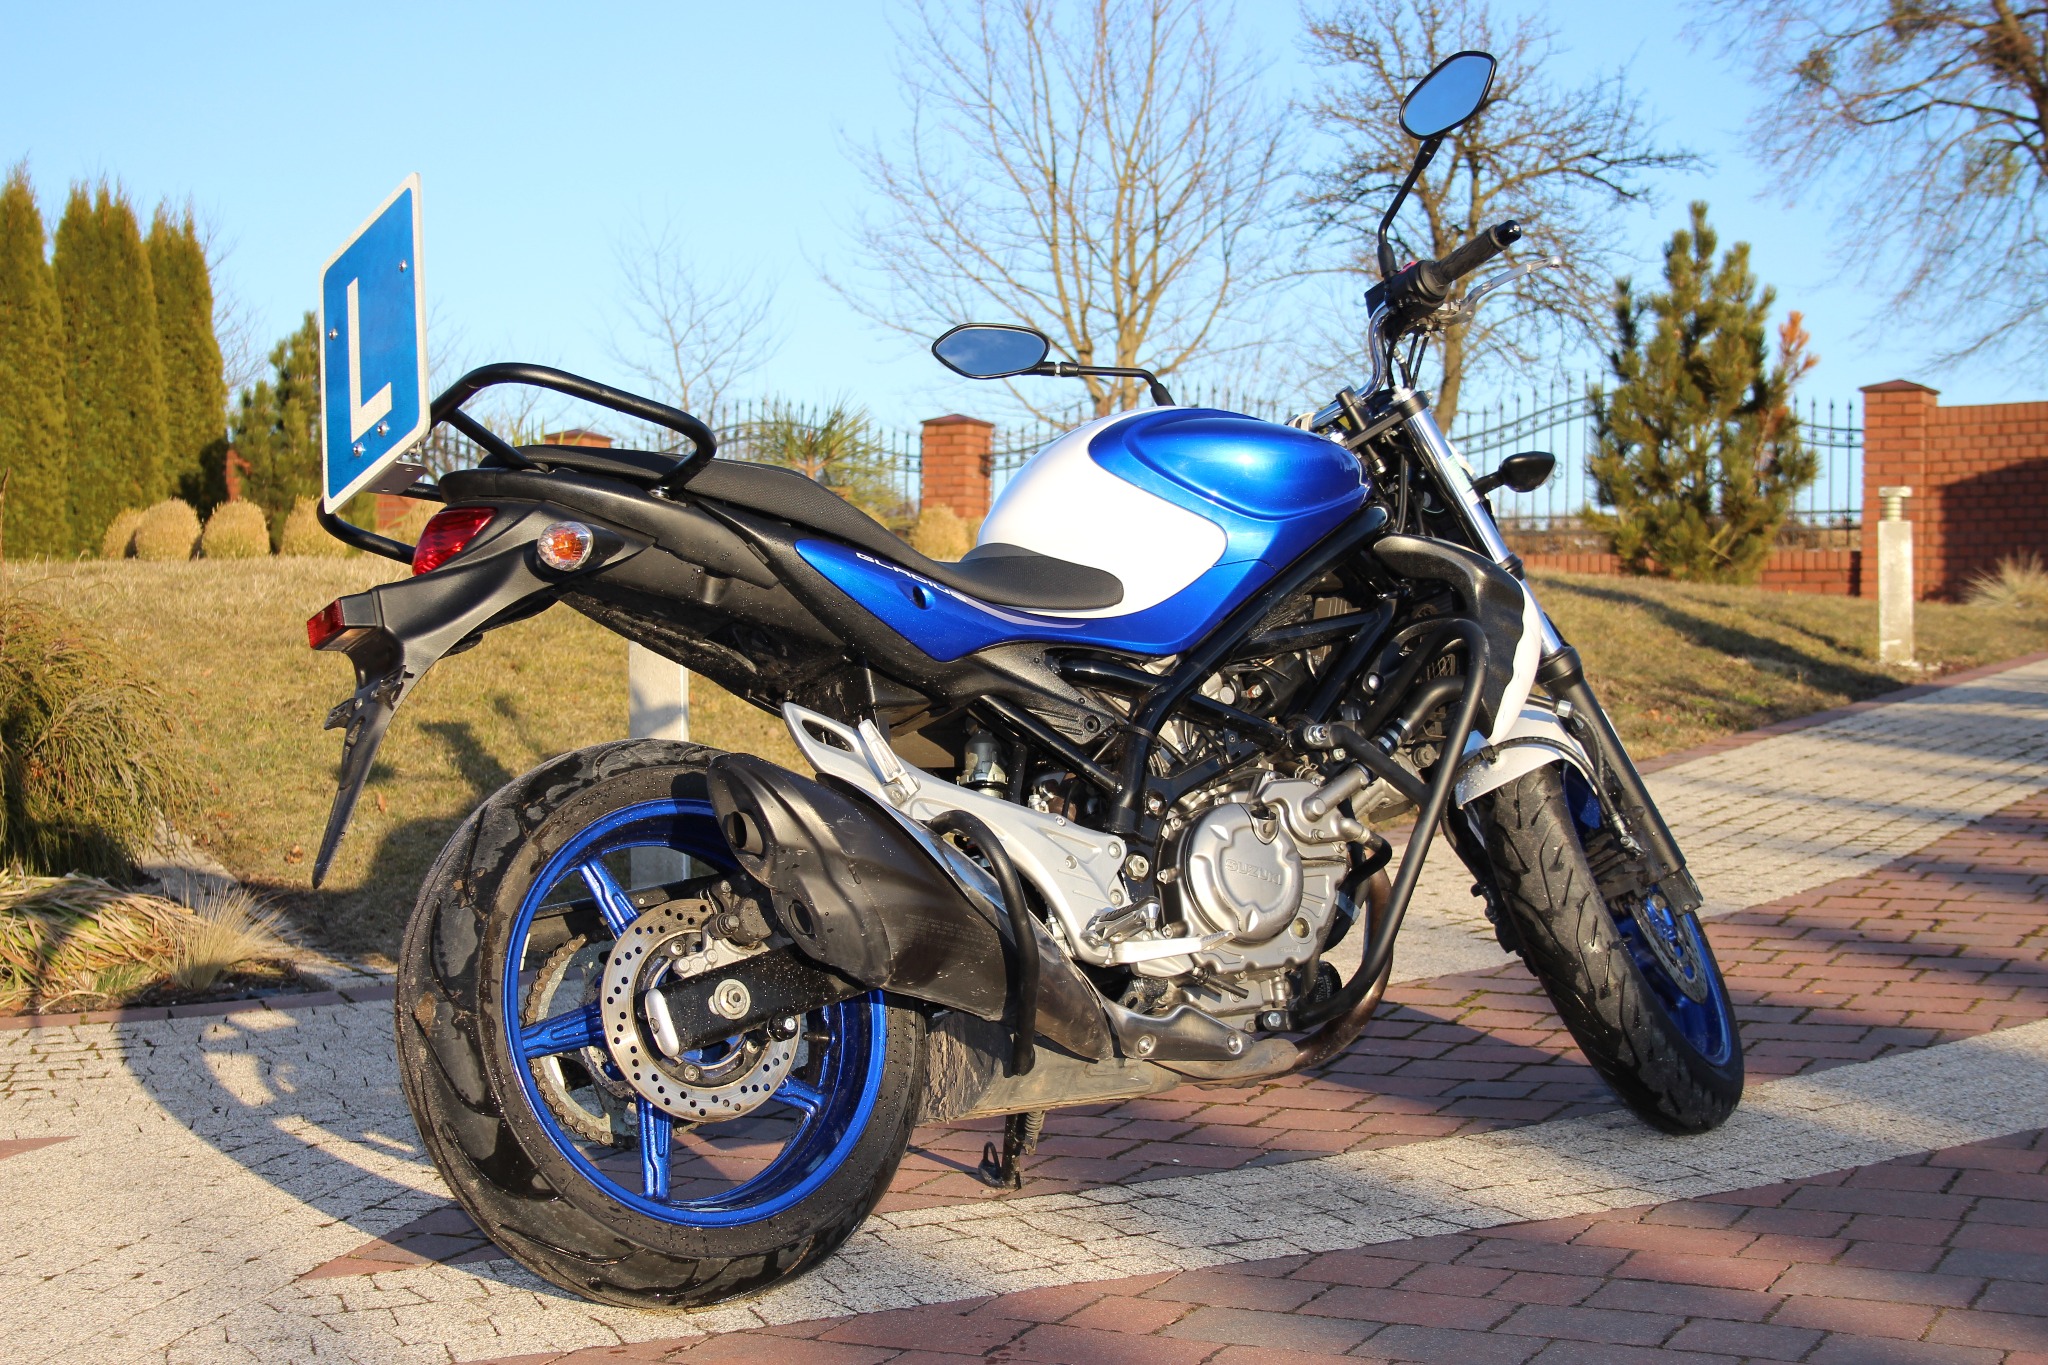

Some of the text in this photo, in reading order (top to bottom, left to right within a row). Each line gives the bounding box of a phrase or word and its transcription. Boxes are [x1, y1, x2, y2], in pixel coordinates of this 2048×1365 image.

[347, 277, 392, 443] L
[856, 552, 967, 602] GLADIUS
[1225, 859, 1281, 885] SUZUKI
